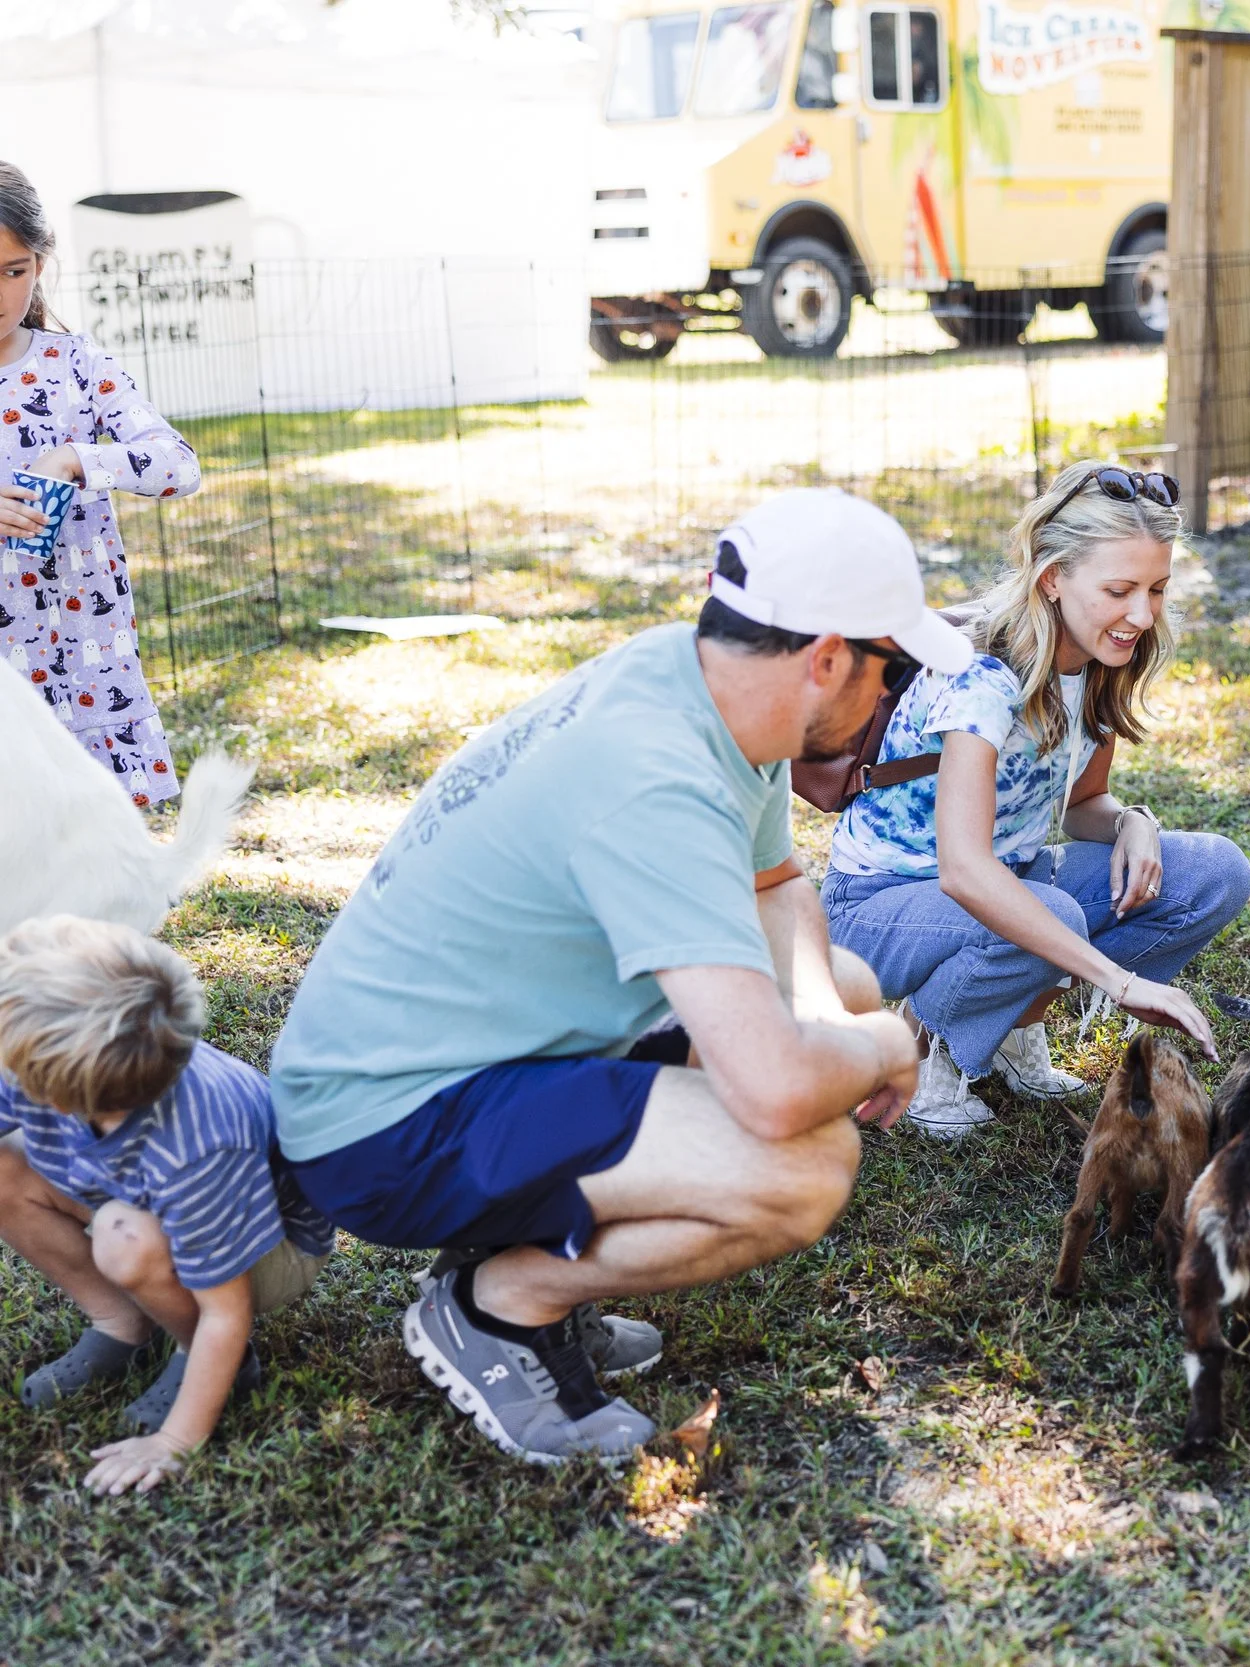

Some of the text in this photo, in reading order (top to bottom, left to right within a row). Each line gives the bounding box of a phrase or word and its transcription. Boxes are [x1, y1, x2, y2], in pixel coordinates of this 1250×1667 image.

[988, 5, 1140, 47] ICE CREAM
[990, 37, 1144, 80] NOVELTIES
